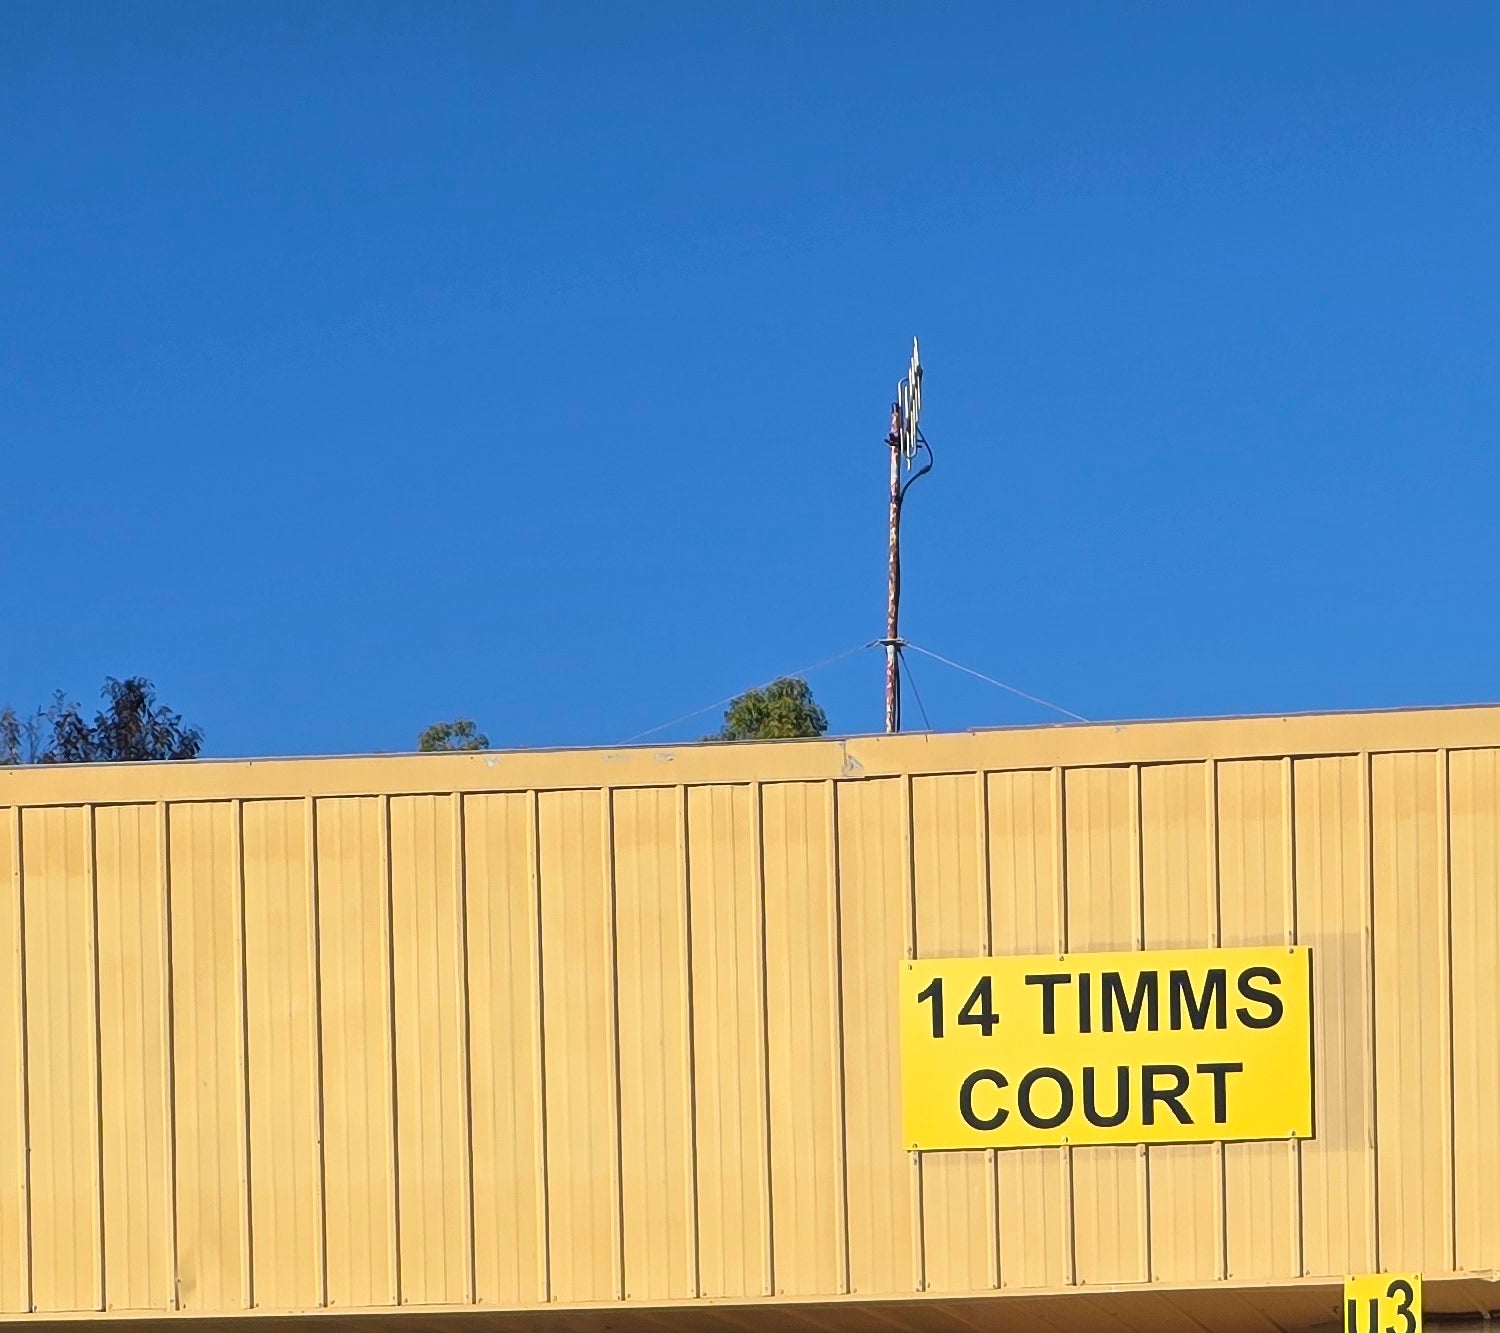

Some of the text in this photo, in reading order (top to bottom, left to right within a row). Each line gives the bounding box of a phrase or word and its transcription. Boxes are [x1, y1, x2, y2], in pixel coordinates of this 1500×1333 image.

[917, 966, 1284, 1039] 14 TIMMS
[959, 1062, 1244, 1131] COURT
